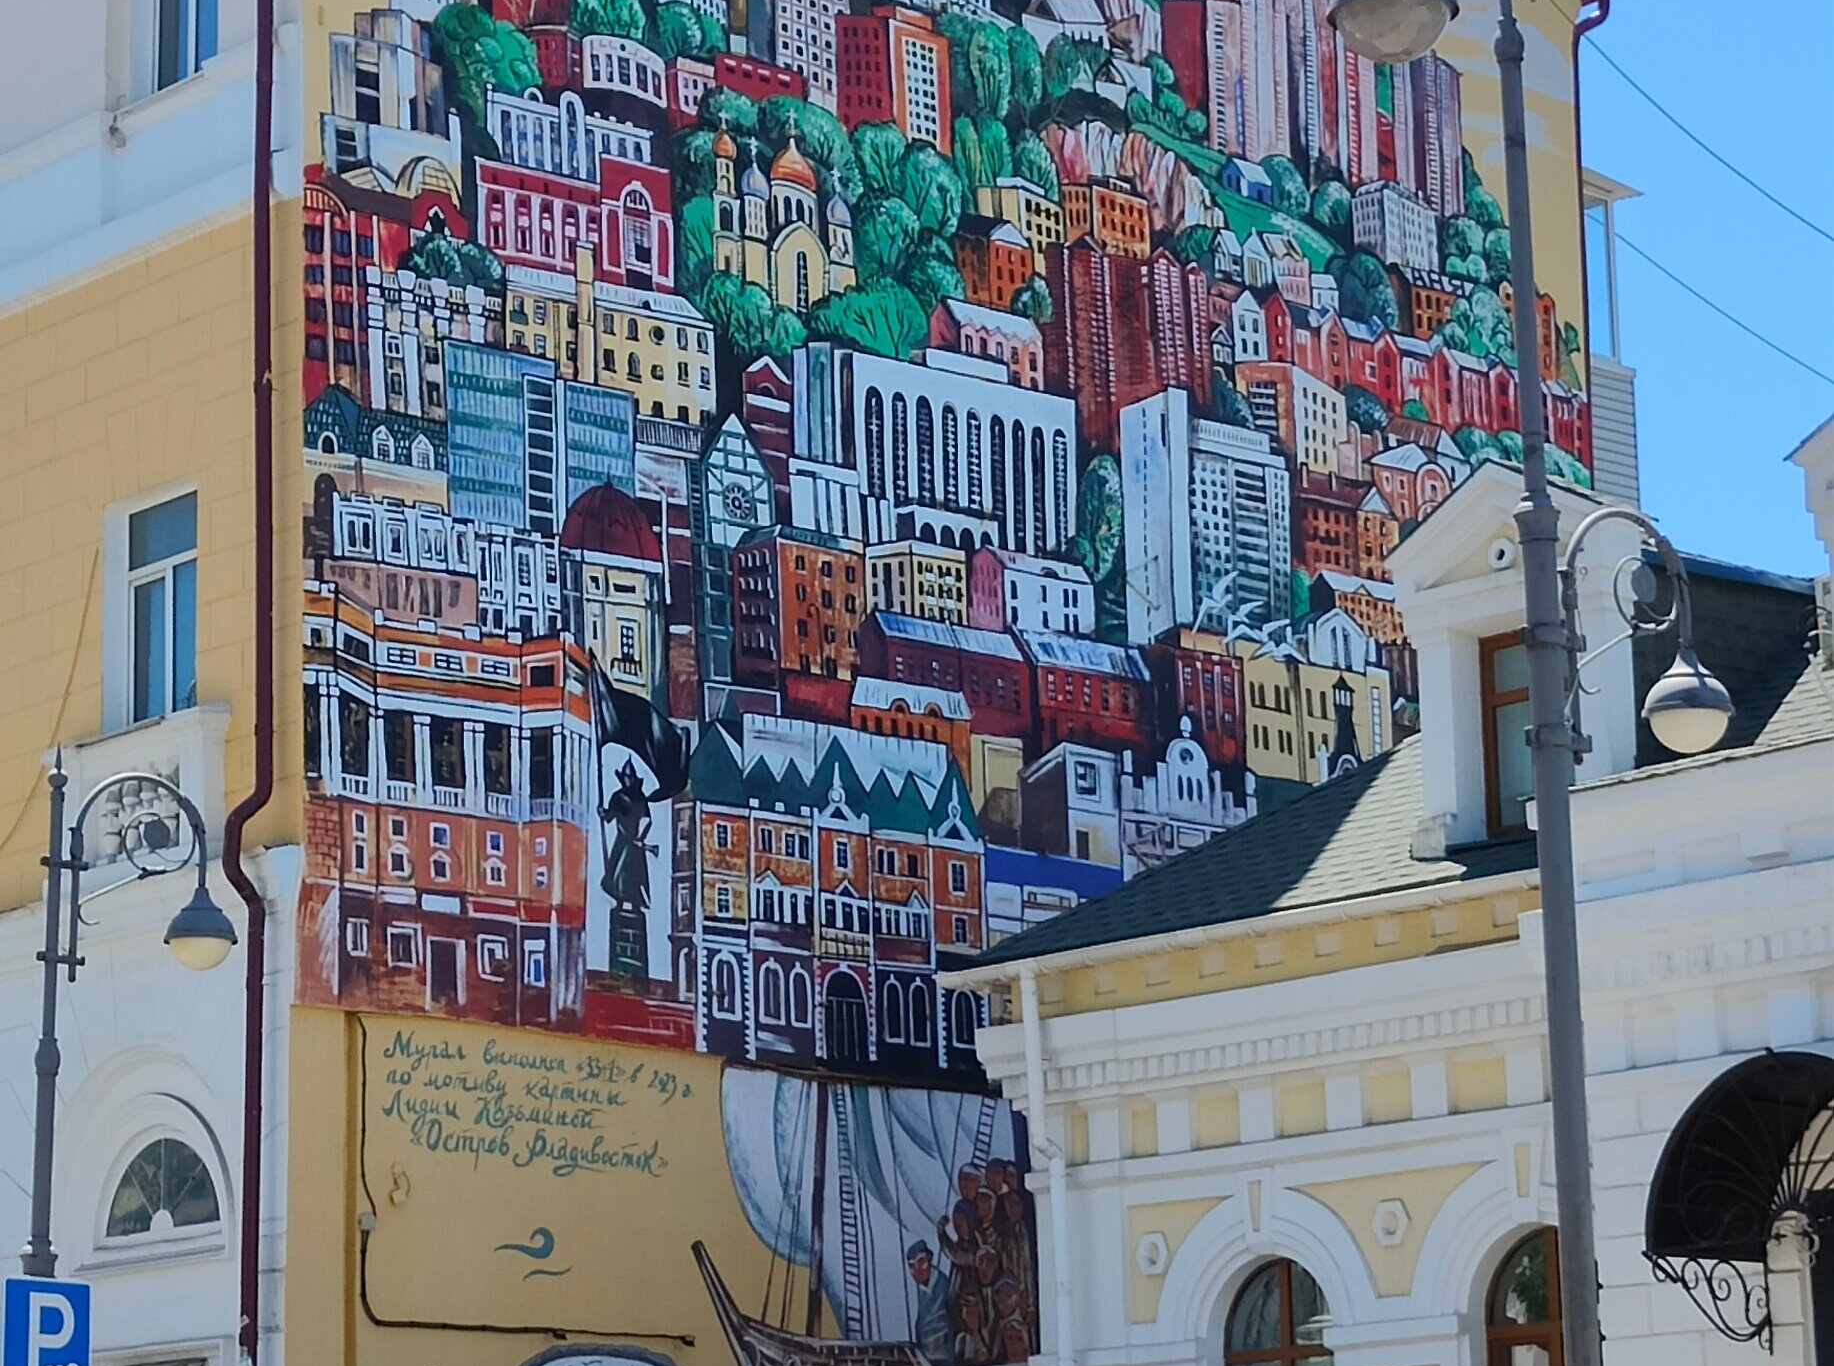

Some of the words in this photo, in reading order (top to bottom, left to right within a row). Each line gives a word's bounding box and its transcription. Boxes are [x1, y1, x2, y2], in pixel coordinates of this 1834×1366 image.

[383, 1030, 466, 1072] Мурал
[386, 1069, 412, 1085] по
[423, 1069, 507, 1100] мотиву
[523, 1076, 628, 1110] картины
[382, 1089, 460, 1135] Лидии
[410, 1118, 514, 1171] «Остров
